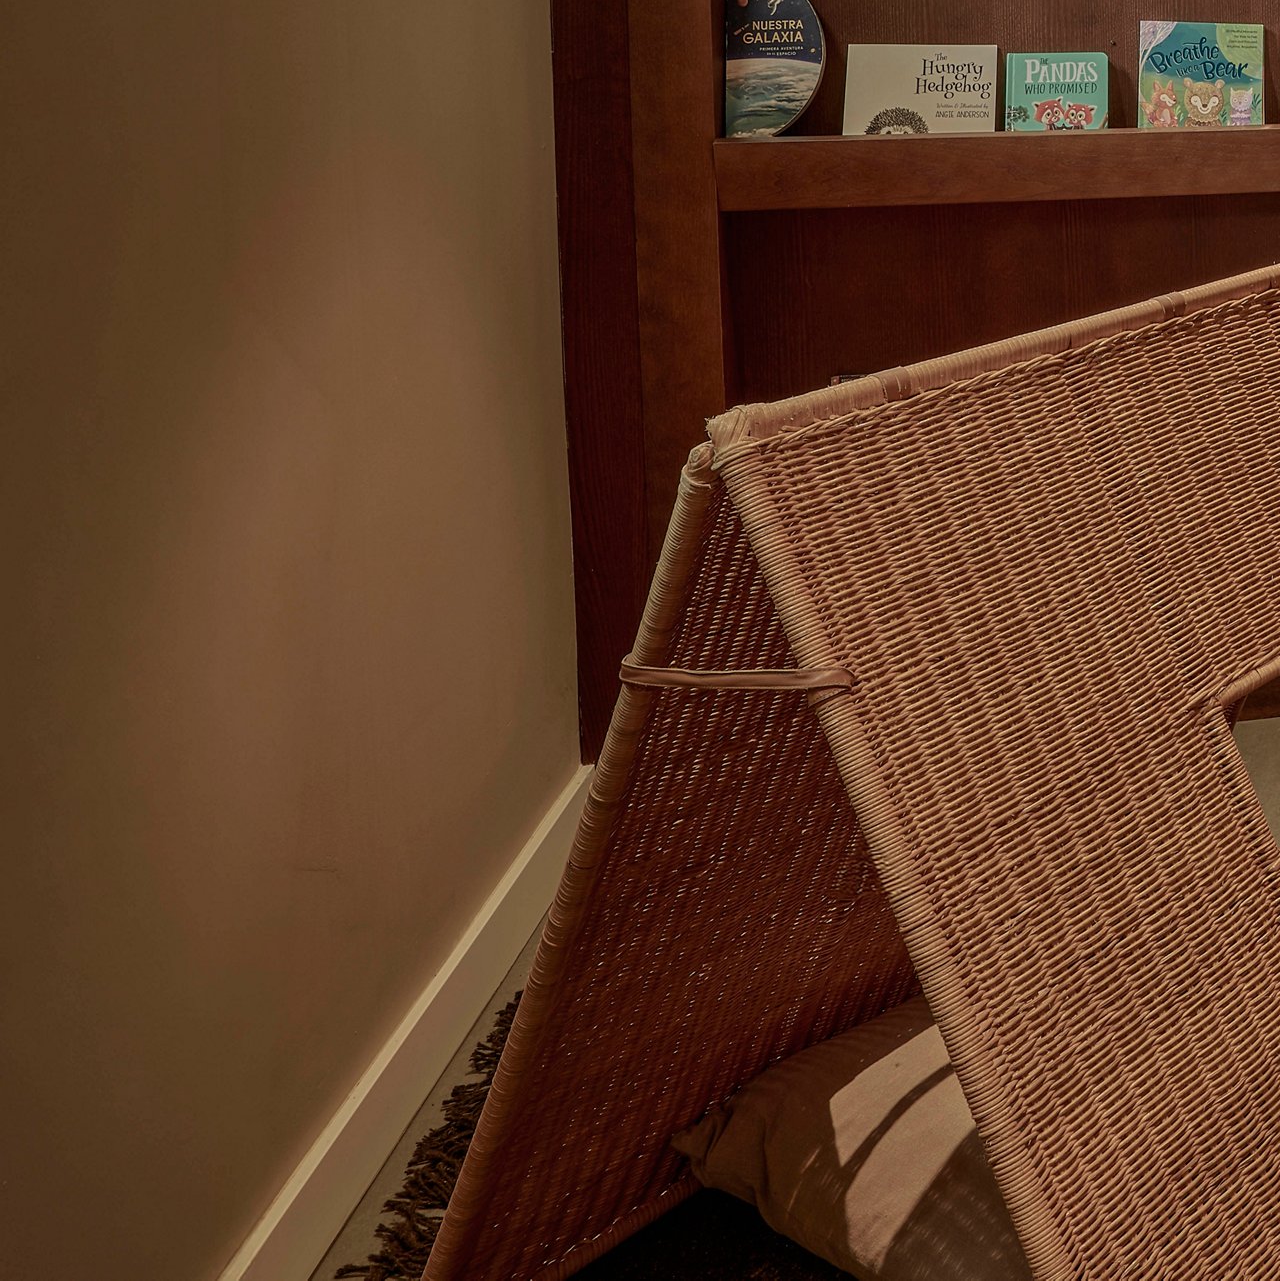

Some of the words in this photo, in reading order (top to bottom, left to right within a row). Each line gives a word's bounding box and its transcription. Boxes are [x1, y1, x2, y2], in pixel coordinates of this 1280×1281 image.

[752, 19, 804, 30] NUESTRA
[743, 31, 804, 44] GALAXIA
[935, 52, 948, 61] The
[1146, 37, 1219, 75] Breathe
[921, 58, 984, 82] Hungry
[1024, 59, 1098, 83] PANDAS
[1176, 66, 1192, 78] like
[1199, 61, 1248, 81] Bear
[913, 75, 992, 99] Hedgehog
[1025, 83, 1046, 95] WHO
[1049, 83, 1098, 94] PROMISED
